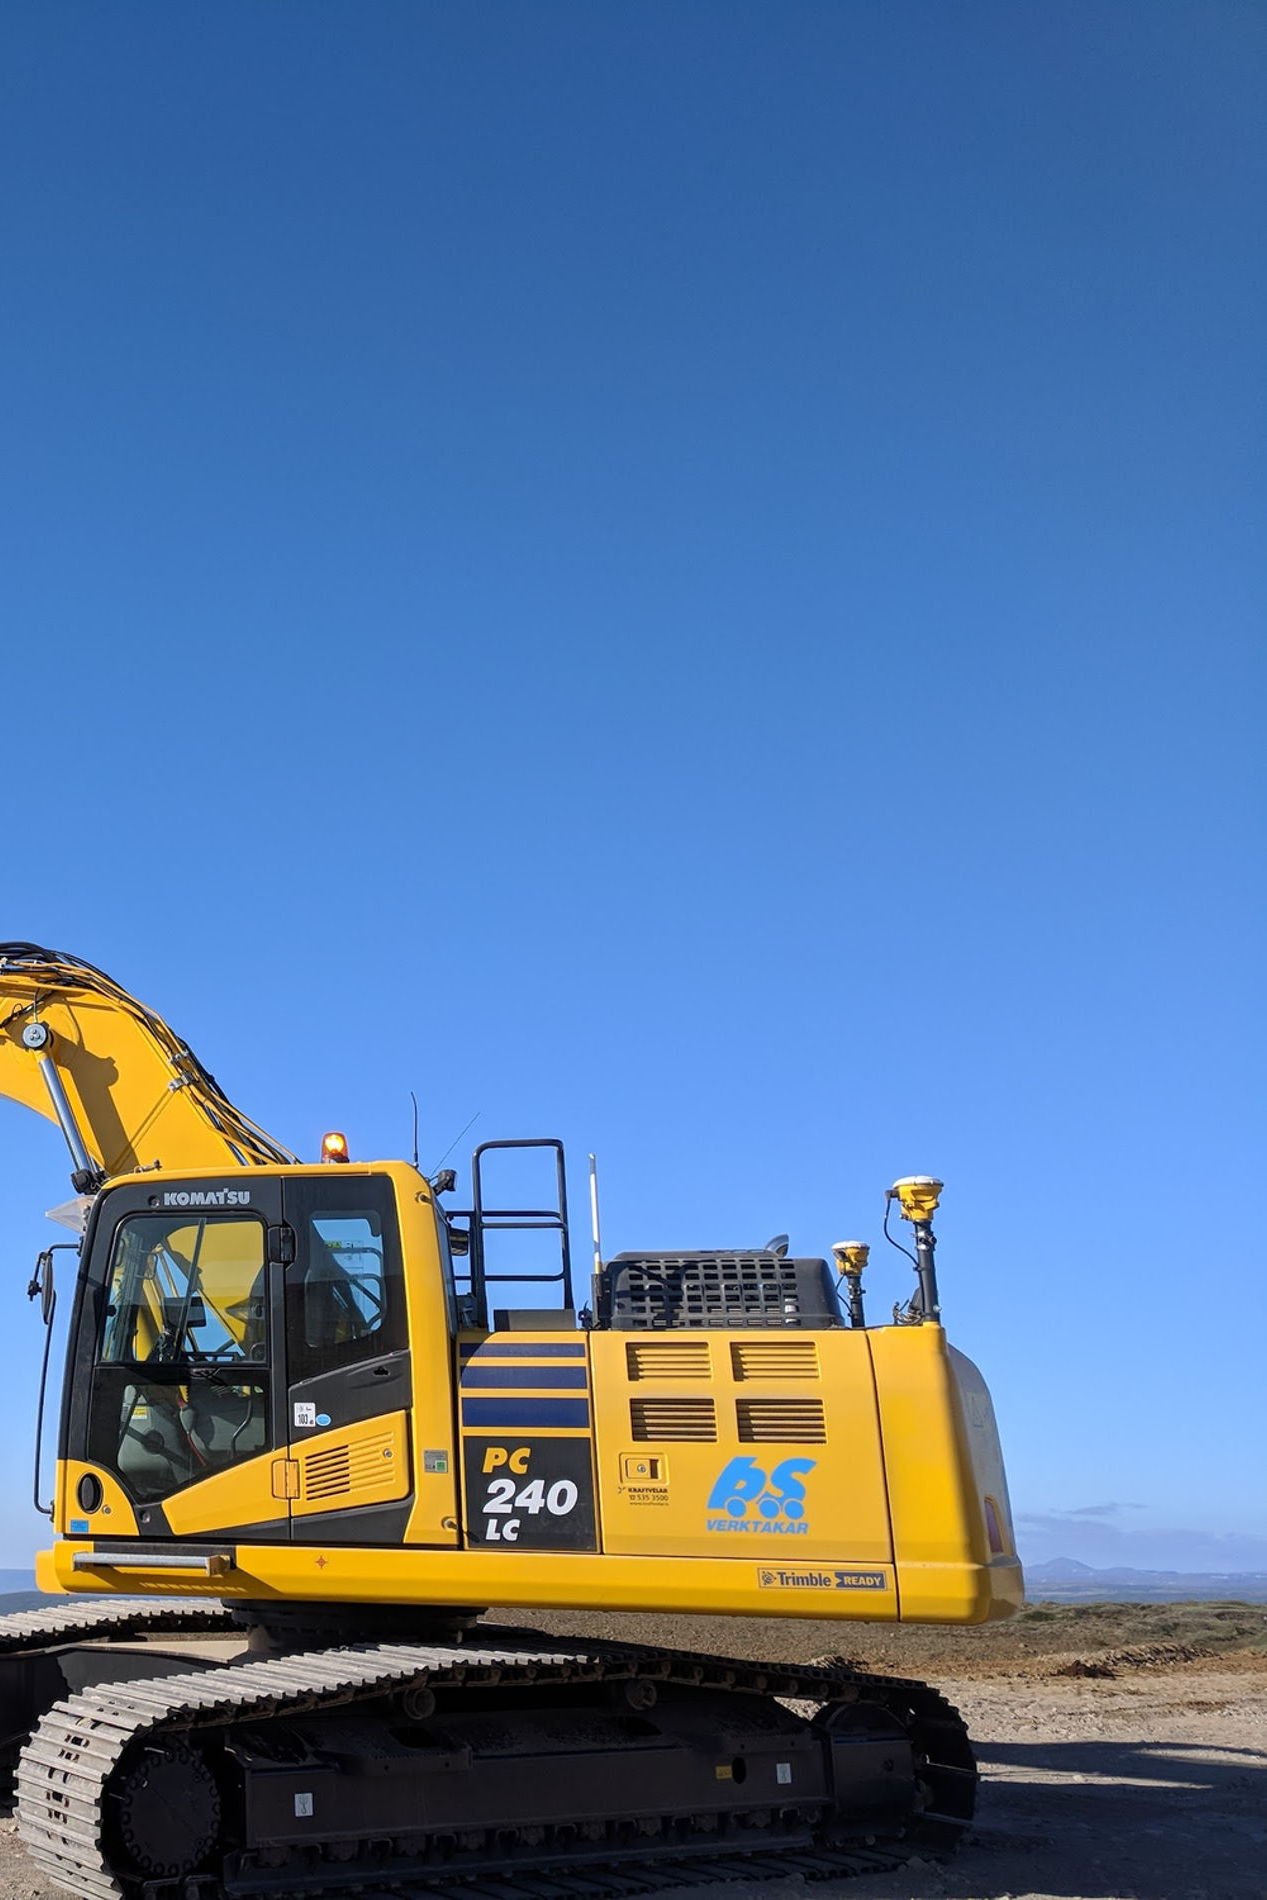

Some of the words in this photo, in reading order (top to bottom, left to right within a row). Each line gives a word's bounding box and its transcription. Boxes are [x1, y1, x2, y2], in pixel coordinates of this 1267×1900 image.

[164, 1188, 250, 1206] KOMATSU
[482, 1447, 531, 1474] PC
[482, 1479, 578, 1516] 240
[485, 1519, 521, 1542] LC
[707, 1519, 809, 1534] VERKTAKAR
[777, 1572, 831, 1587] Trimble
[843, 1576, 881, 1586] READY
